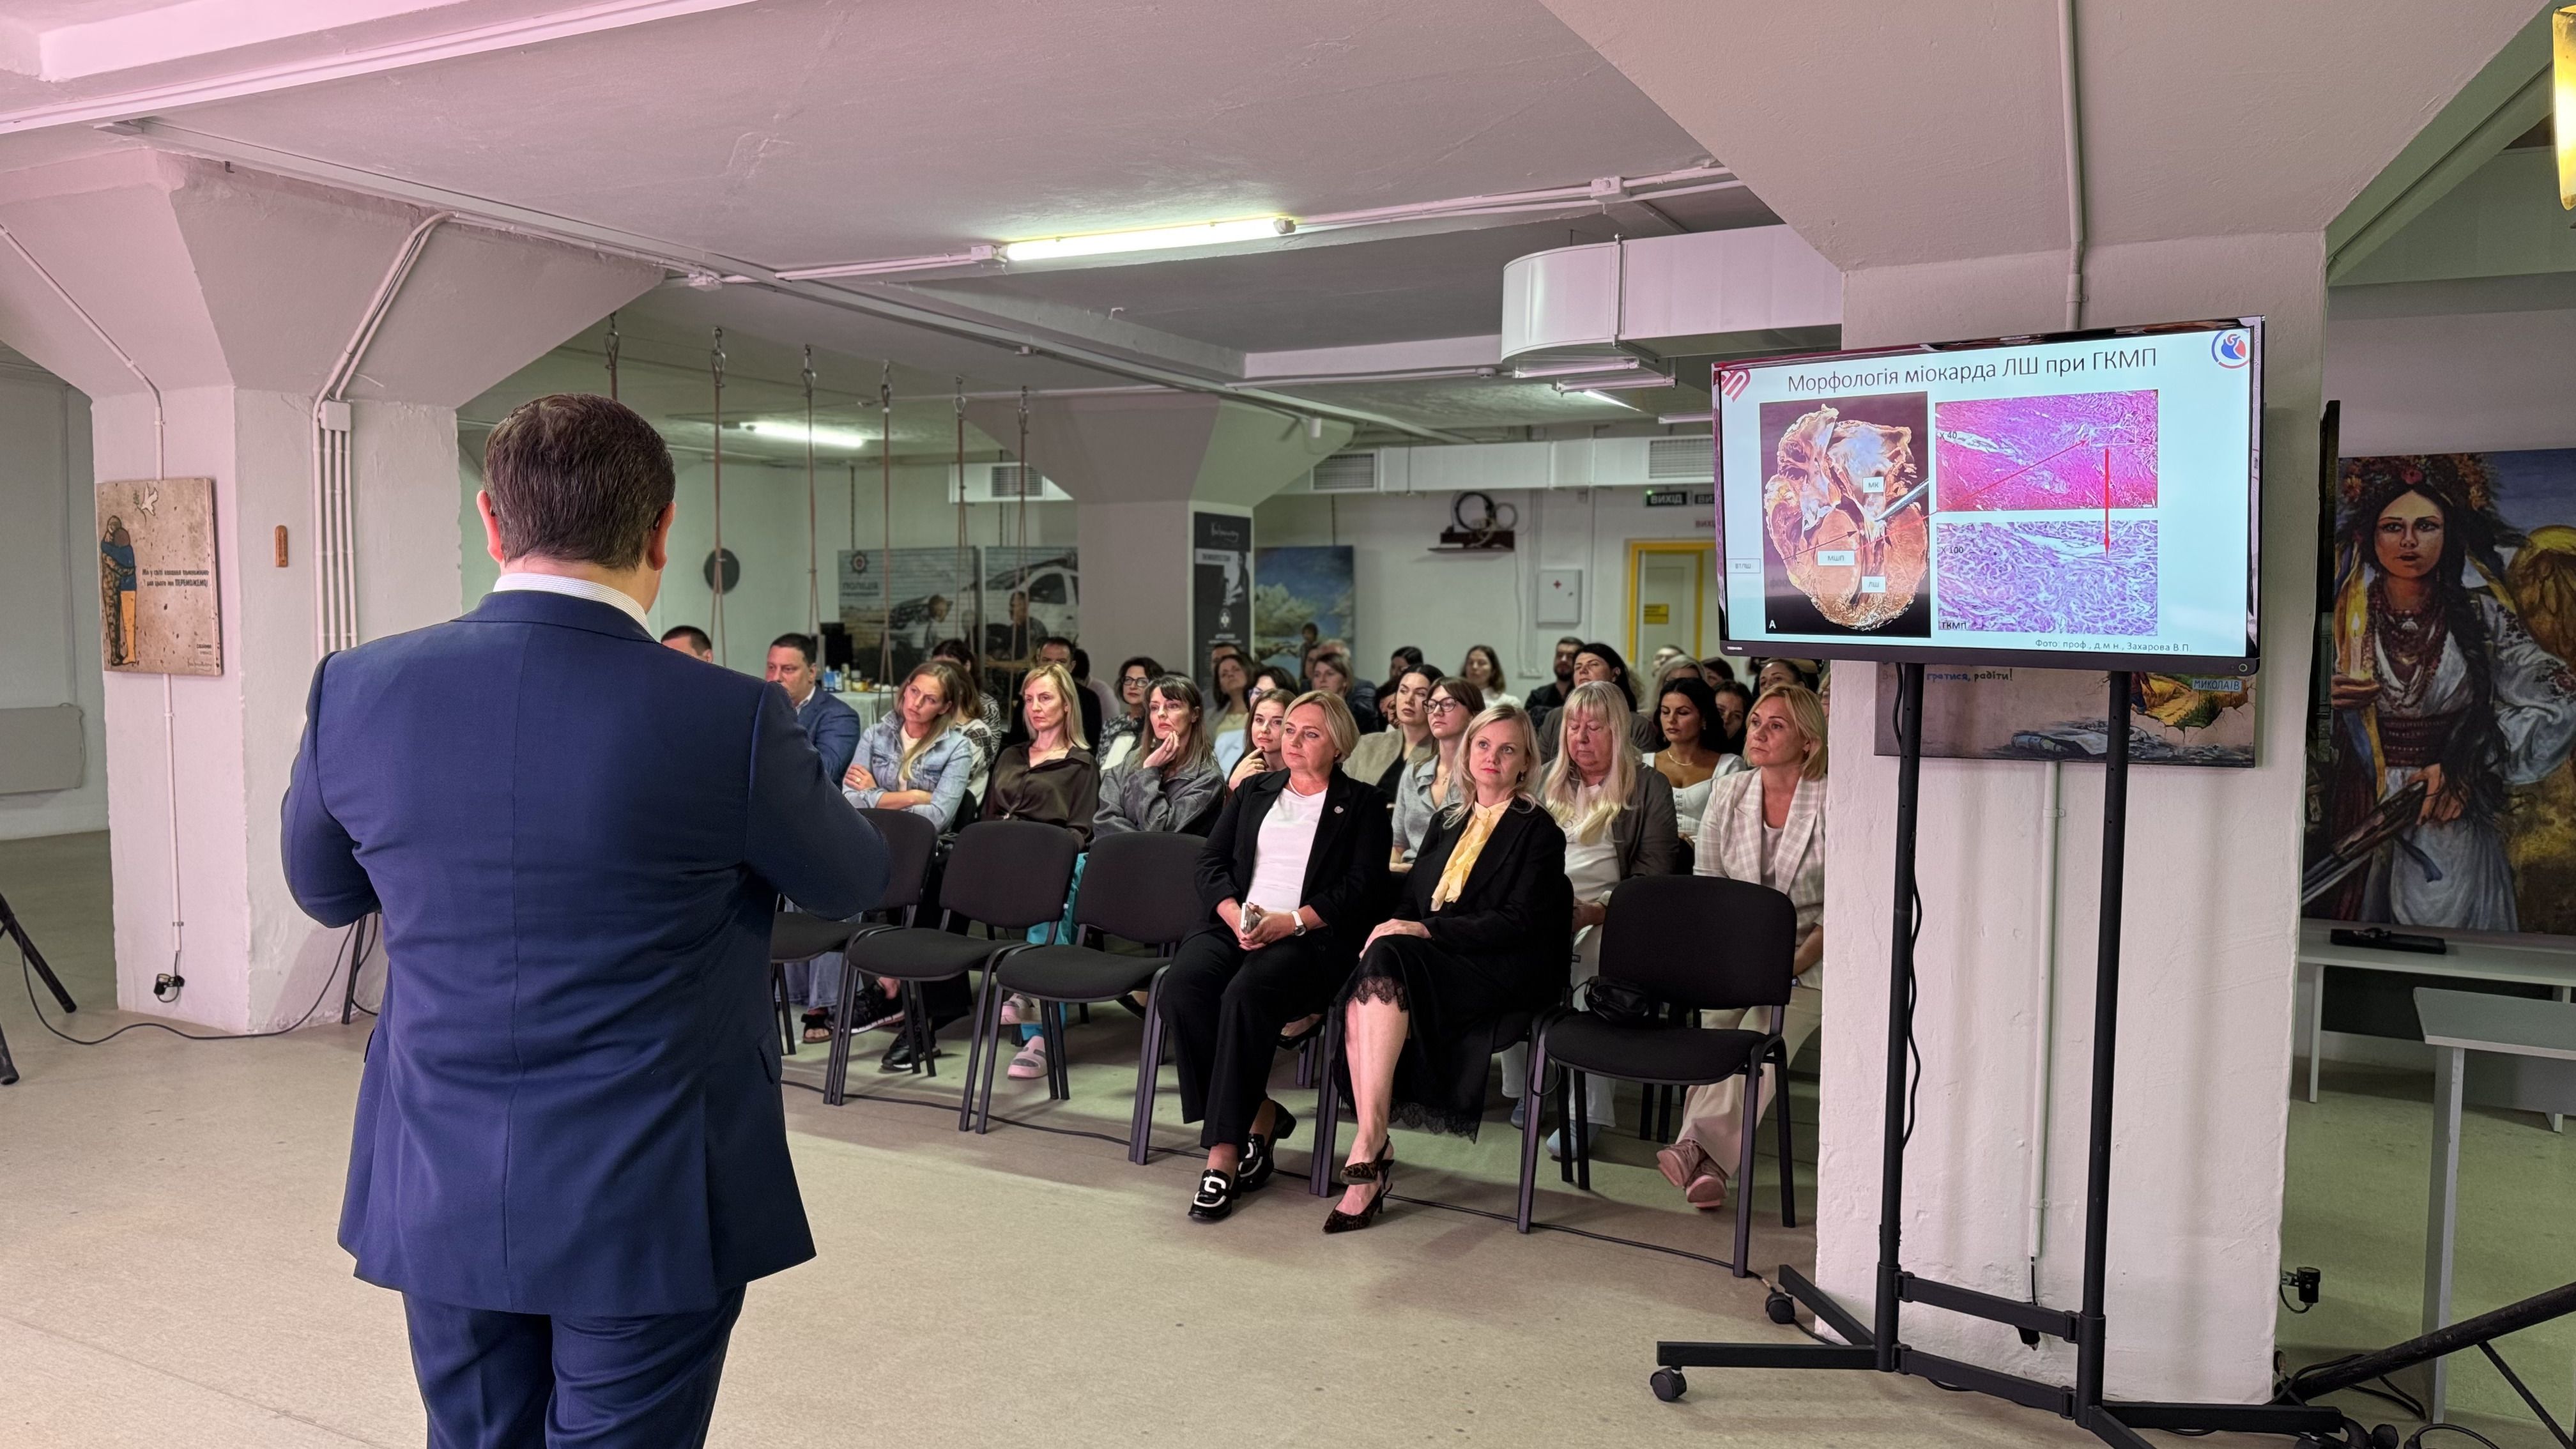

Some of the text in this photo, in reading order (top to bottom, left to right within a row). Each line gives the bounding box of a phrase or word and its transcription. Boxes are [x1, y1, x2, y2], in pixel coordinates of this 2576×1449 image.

[1789, 348, 2156, 394] Морфологія міокарда ЛШ при ГКМП
[1947, 431, 1958, 439] 40
[1651, 494, 1683, 504] ВИХІД
[2127, 642, 2170, 652] Захарова
[1926, 668, 2012, 682] гратися, радіти!
